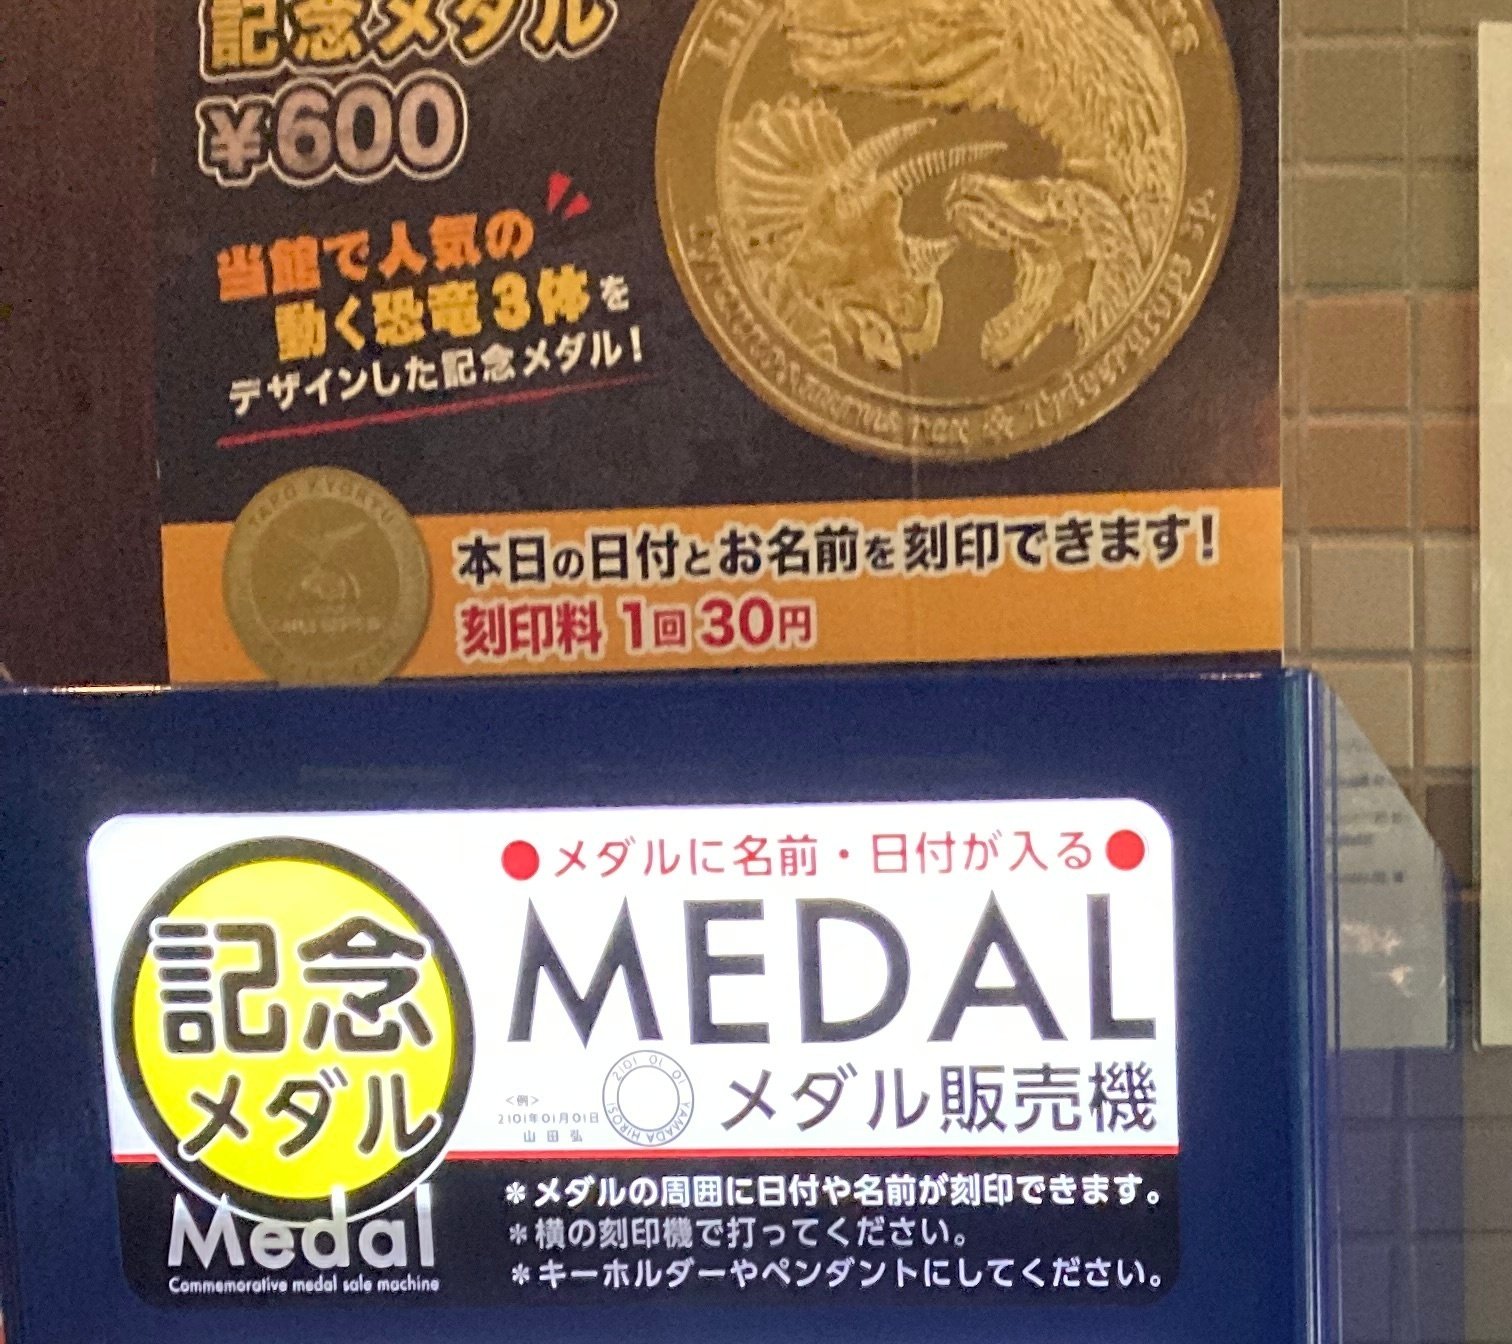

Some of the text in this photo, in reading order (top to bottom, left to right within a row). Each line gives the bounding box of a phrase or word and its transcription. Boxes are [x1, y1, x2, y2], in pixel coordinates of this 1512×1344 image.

[199, 71, 464, 186] ¥600
[217, 209, 534, 301] 当館で人気の
[275, 266, 629, 362] 動く恐竜3体を
[229, 326, 643, 417] デザインした記念メダル!
[456, 511, 1219, 585] 本日の日付とお名前を刻印できます!
[555, 830, 1093, 878] メダルに名前・日付が入る
[154, 916, 434, 1055] 記念
[507, 890, 1157, 1050] MEDAL
[181, 1067, 439, 1159] メダル
[721, 1062, 1157, 1134] メダル販売機
[168, 1183, 436, 1269] Medal
[169, 1276, 439, 1295] Commemorative medal sale machine
[539, 1258, 1163, 1289] キーホルダーやペンダントにしてください。
